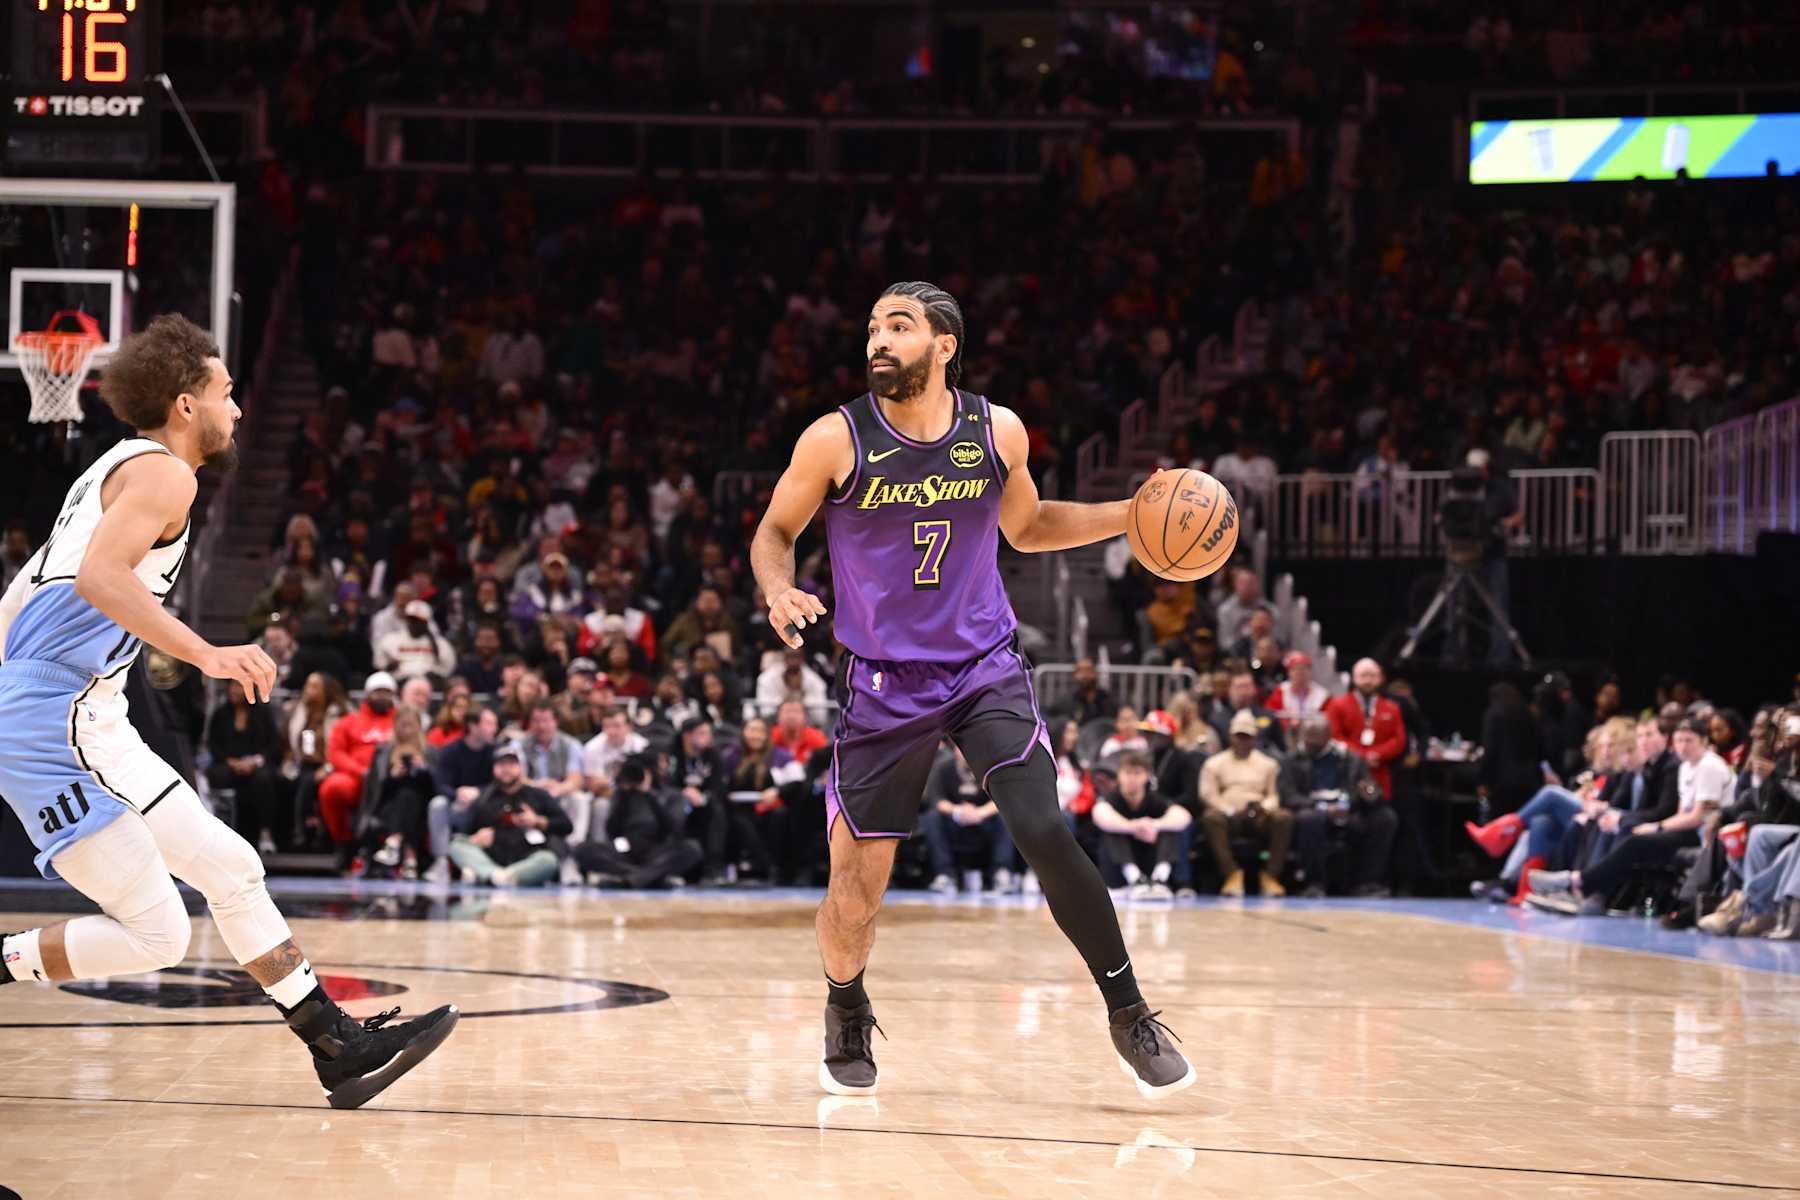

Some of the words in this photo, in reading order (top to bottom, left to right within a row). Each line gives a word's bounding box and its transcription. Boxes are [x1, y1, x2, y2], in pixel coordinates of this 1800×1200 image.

[62, 12, 127, 82] 16
[49, 96, 144, 116] TISSOT
[952, 448, 982, 462] bibigo
[913, 519, 951, 586] 7
[38, 781, 91, 834] atl
